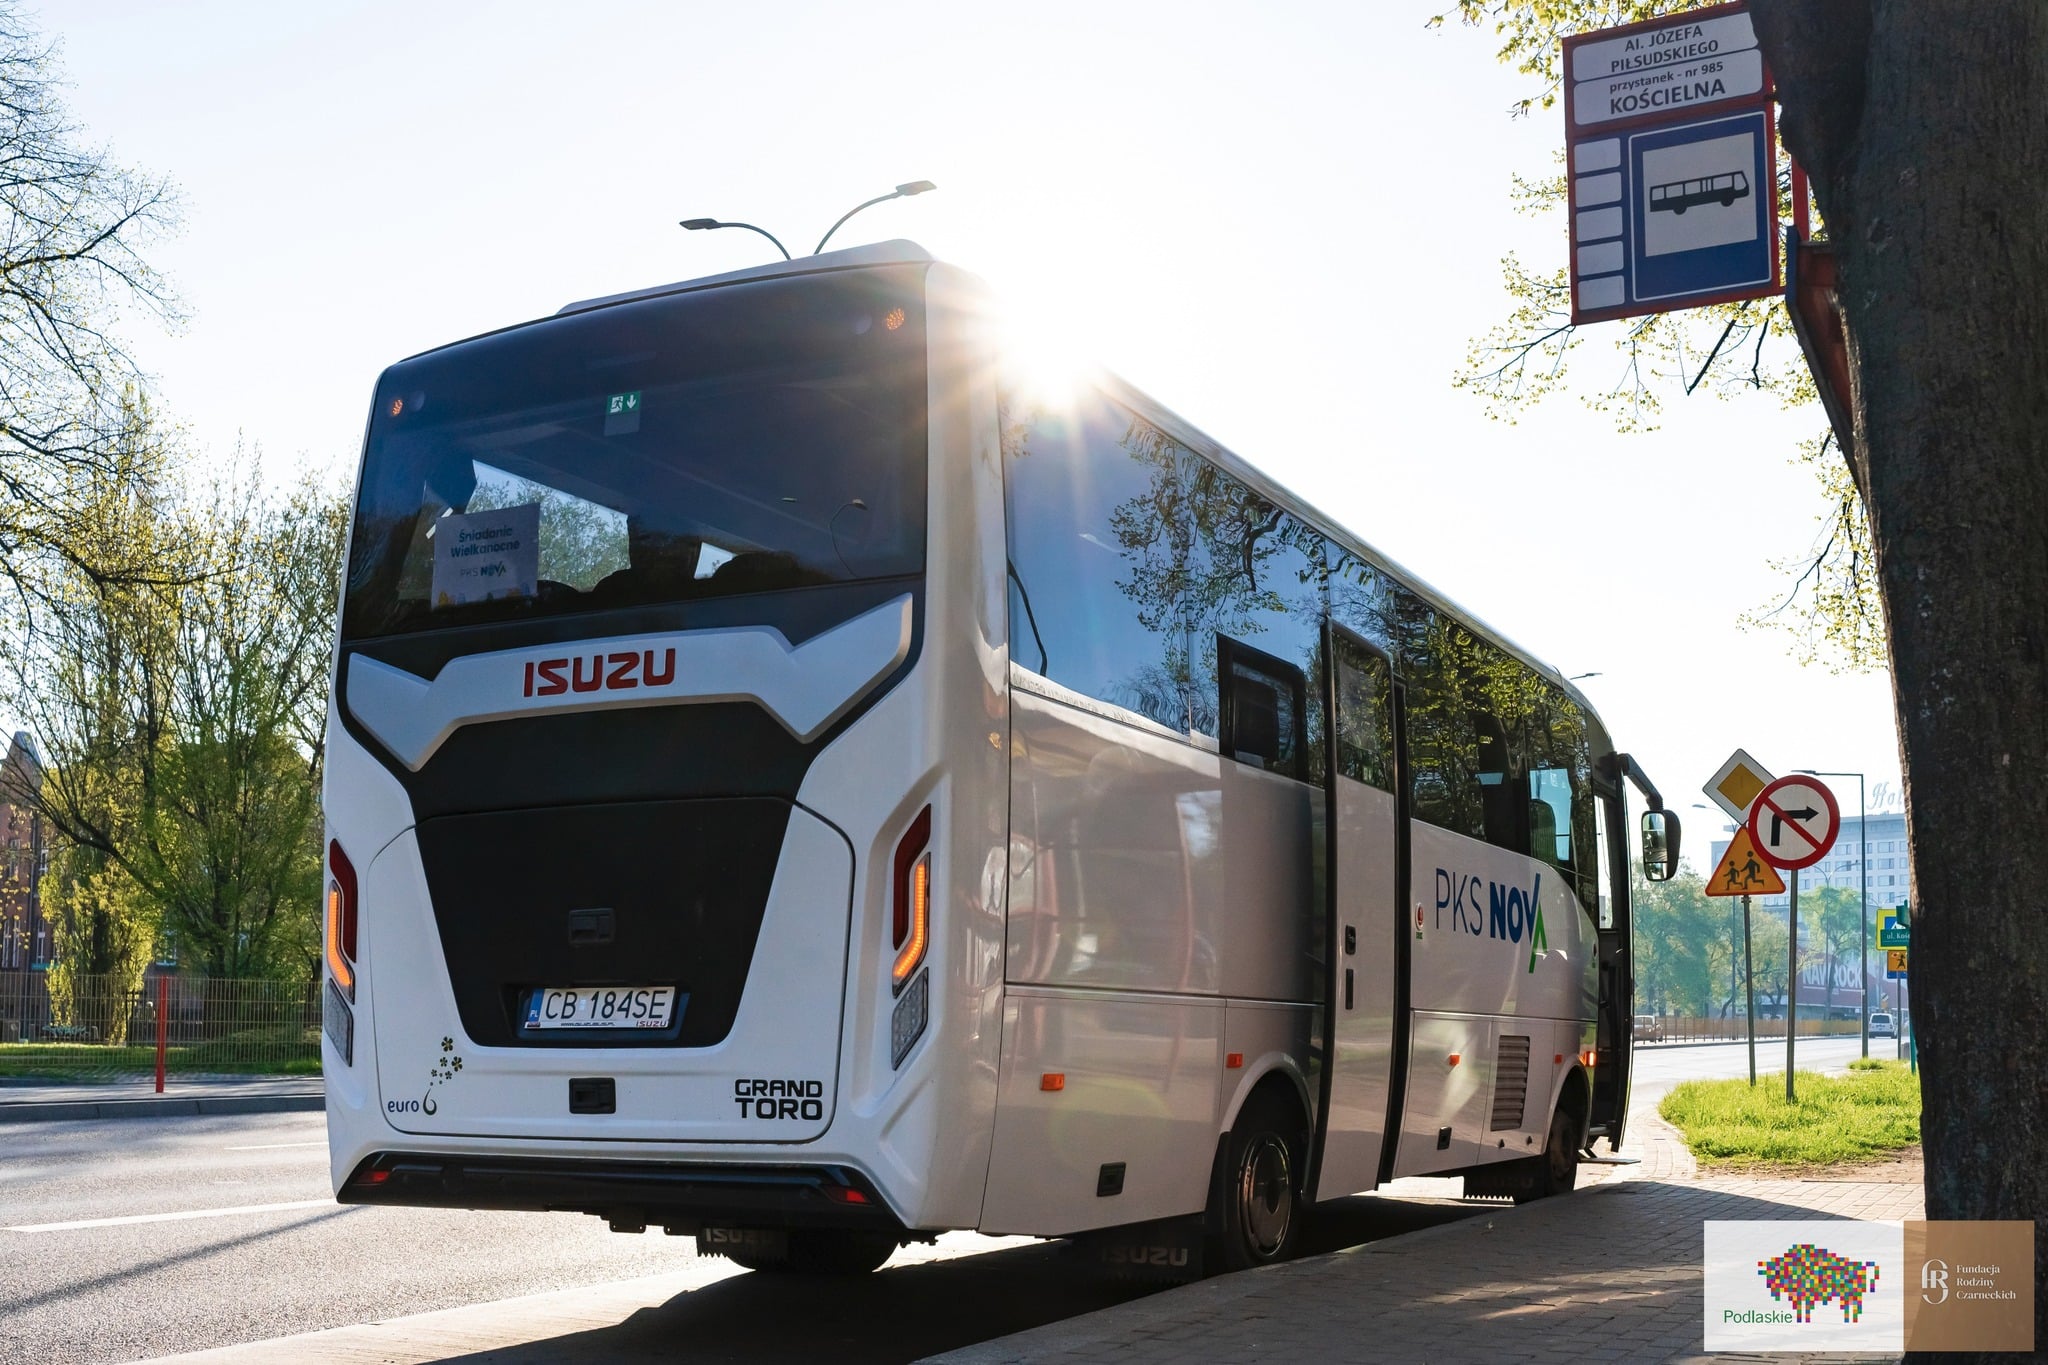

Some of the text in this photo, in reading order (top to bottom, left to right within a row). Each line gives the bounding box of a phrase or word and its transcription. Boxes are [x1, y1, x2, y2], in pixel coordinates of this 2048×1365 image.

[1648, 24, 1703, 48] JÓZEFA
[1611, 39, 1719, 73] PIŁSUDSKIEGO
[1609, 70, 1674, 94] przystanek
[1685, 67, 1698, 78] nr
[1701, 61, 1724, 75] 985
[1609, 79, 1726, 115] KOŚCIELNA
[450, 539, 521, 558] Wielkanocne
[523, 648, 676, 698] ISUZU
[1436, 868, 1548, 974] PKS NOVA
[529, 1010, 539, 1018] PL
[545, 990, 668, 1020] CB 184SE
[635, 1020, 667, 1028] ISUZU
[735, 1079, 823, 1098] GRAND
[387, 1100, 420, 1113] euro
[735, 1098, 823, 1121] TORO
